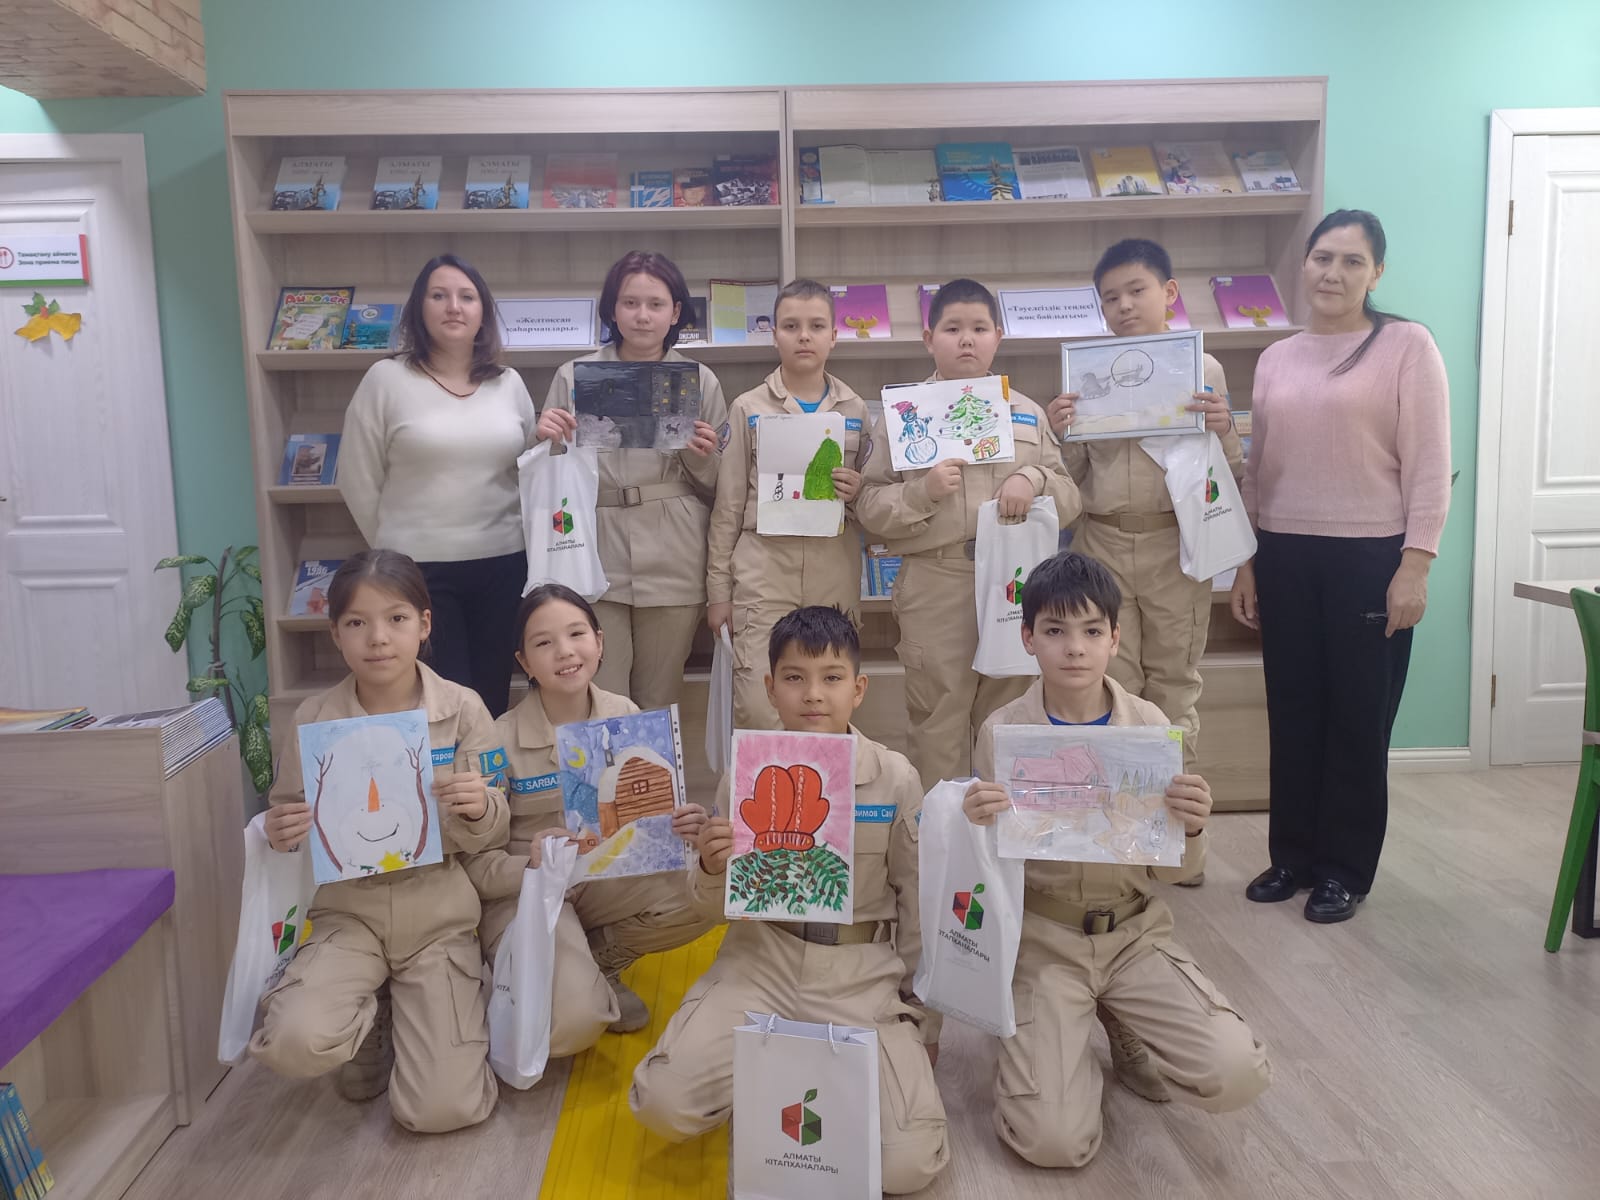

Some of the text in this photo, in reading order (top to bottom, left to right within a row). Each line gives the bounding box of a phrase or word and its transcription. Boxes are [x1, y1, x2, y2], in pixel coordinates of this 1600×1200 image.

[949, 928, 978, 949] АЛМАТЫ
[783, 1152, 822, 1163] АЛМАТЫ
[765, 1158, 838, 1174] КІТАПХАНАЛАРЫ
